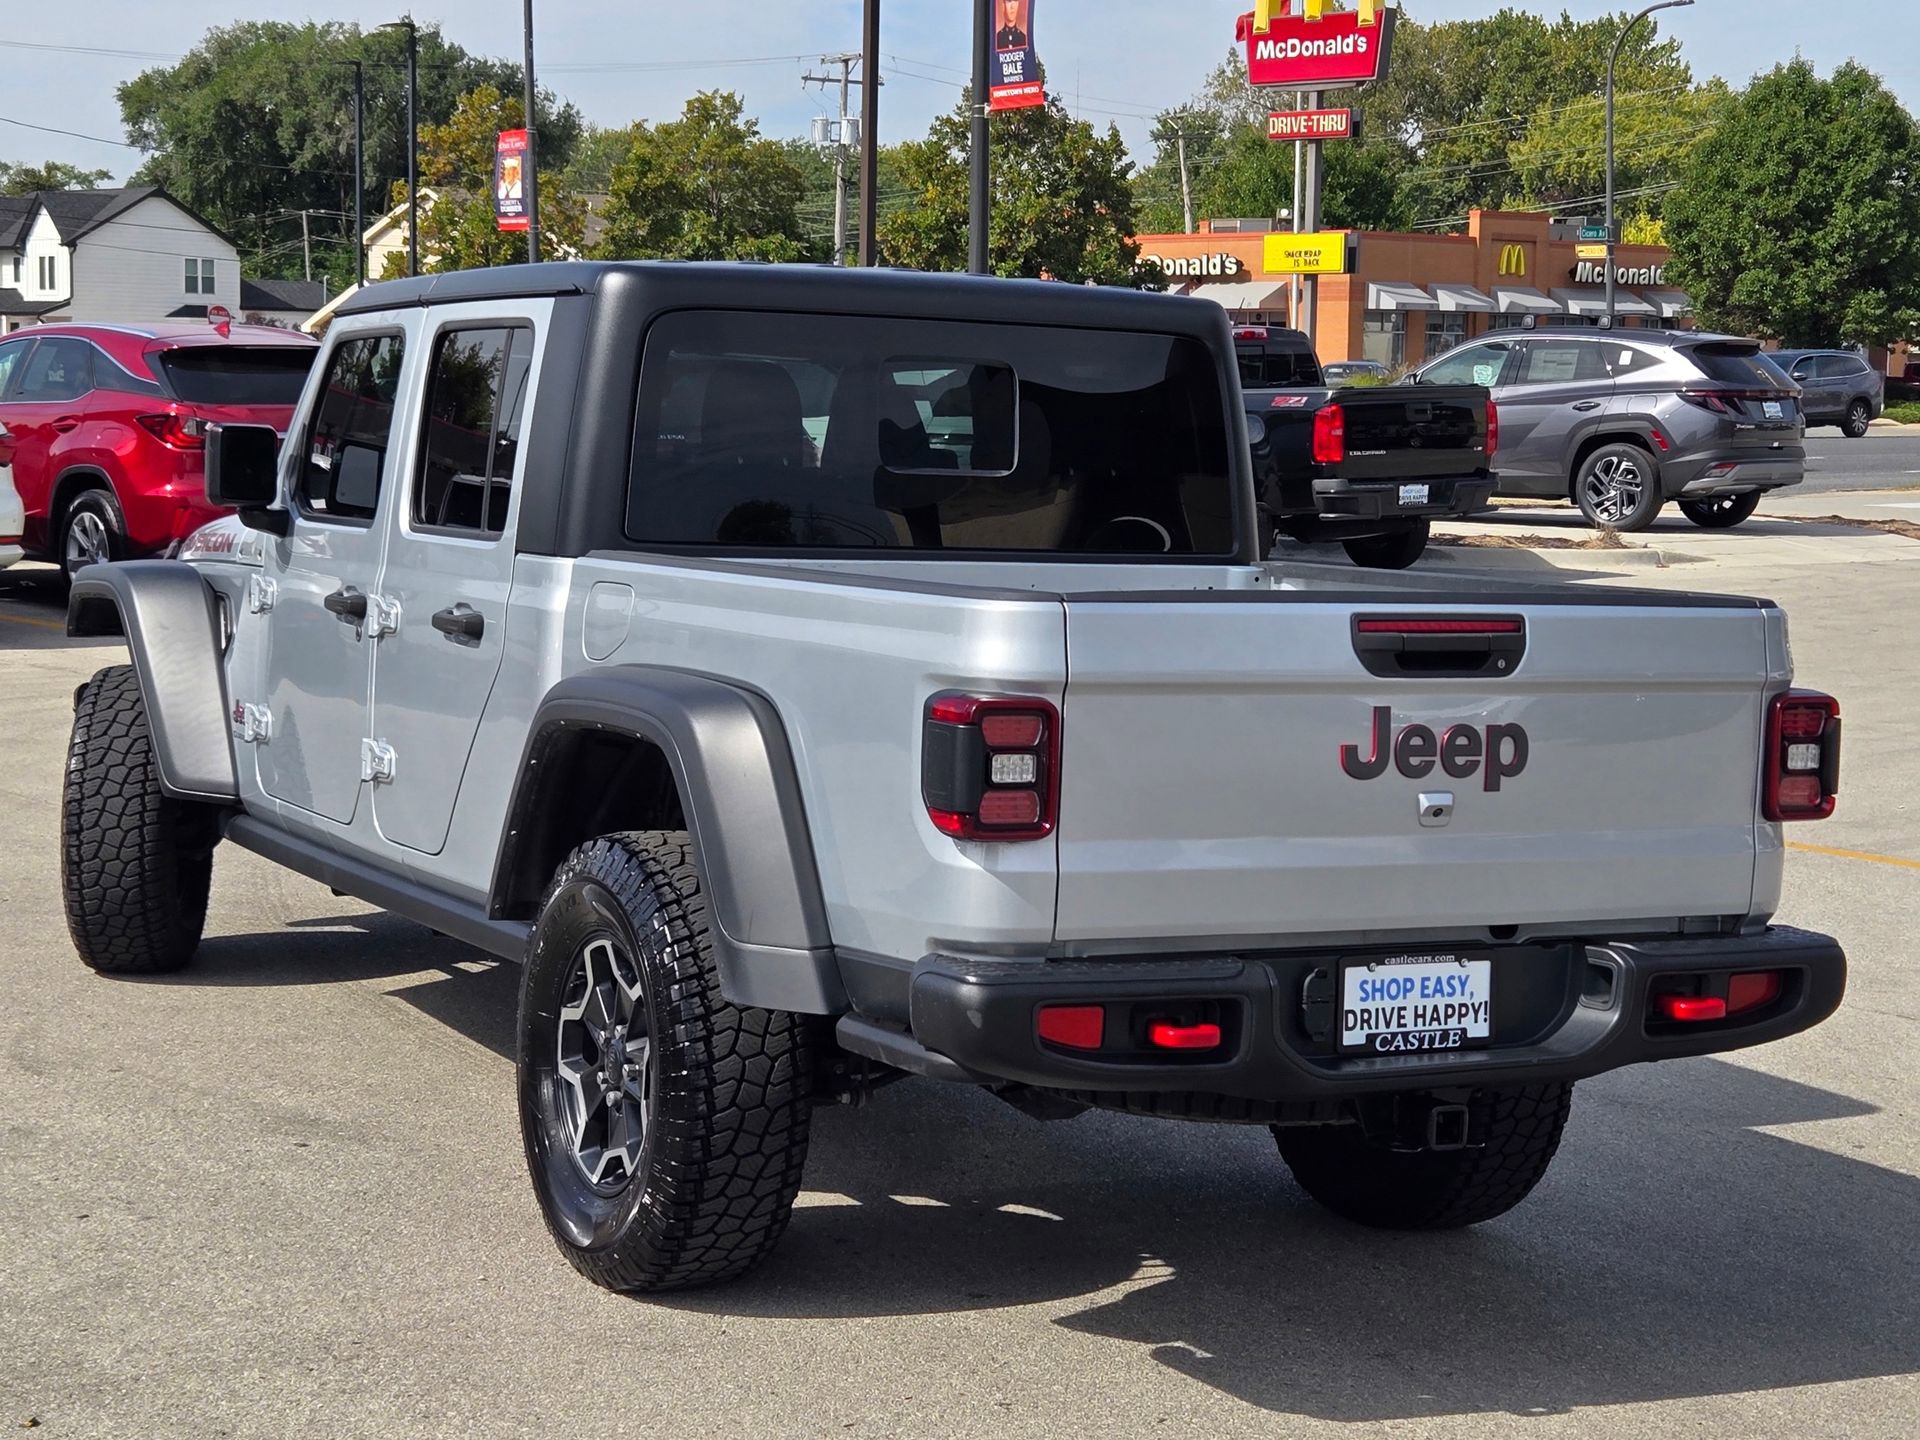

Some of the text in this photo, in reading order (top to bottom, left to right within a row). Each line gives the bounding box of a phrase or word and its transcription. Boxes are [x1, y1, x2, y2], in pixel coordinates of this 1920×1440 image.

[999, 51, 1025, 63] RODGER
[1255, 33, 1368, 60] McDonald's
[1002, 62, 1023, 75] BALE
[1269, 113, 1347, 135] DRIVE-THRU
[1339, 705, 1529, 793] Jeep
[1384, 954, 1456, 966] castlecars.com
[1359, 974, 1474, 1003] SHOP EASY,
[1344, 1000, 1489, 1032] DRIVE HAPPY!
[1375, 1029, 1462, 1051] CASTLE
